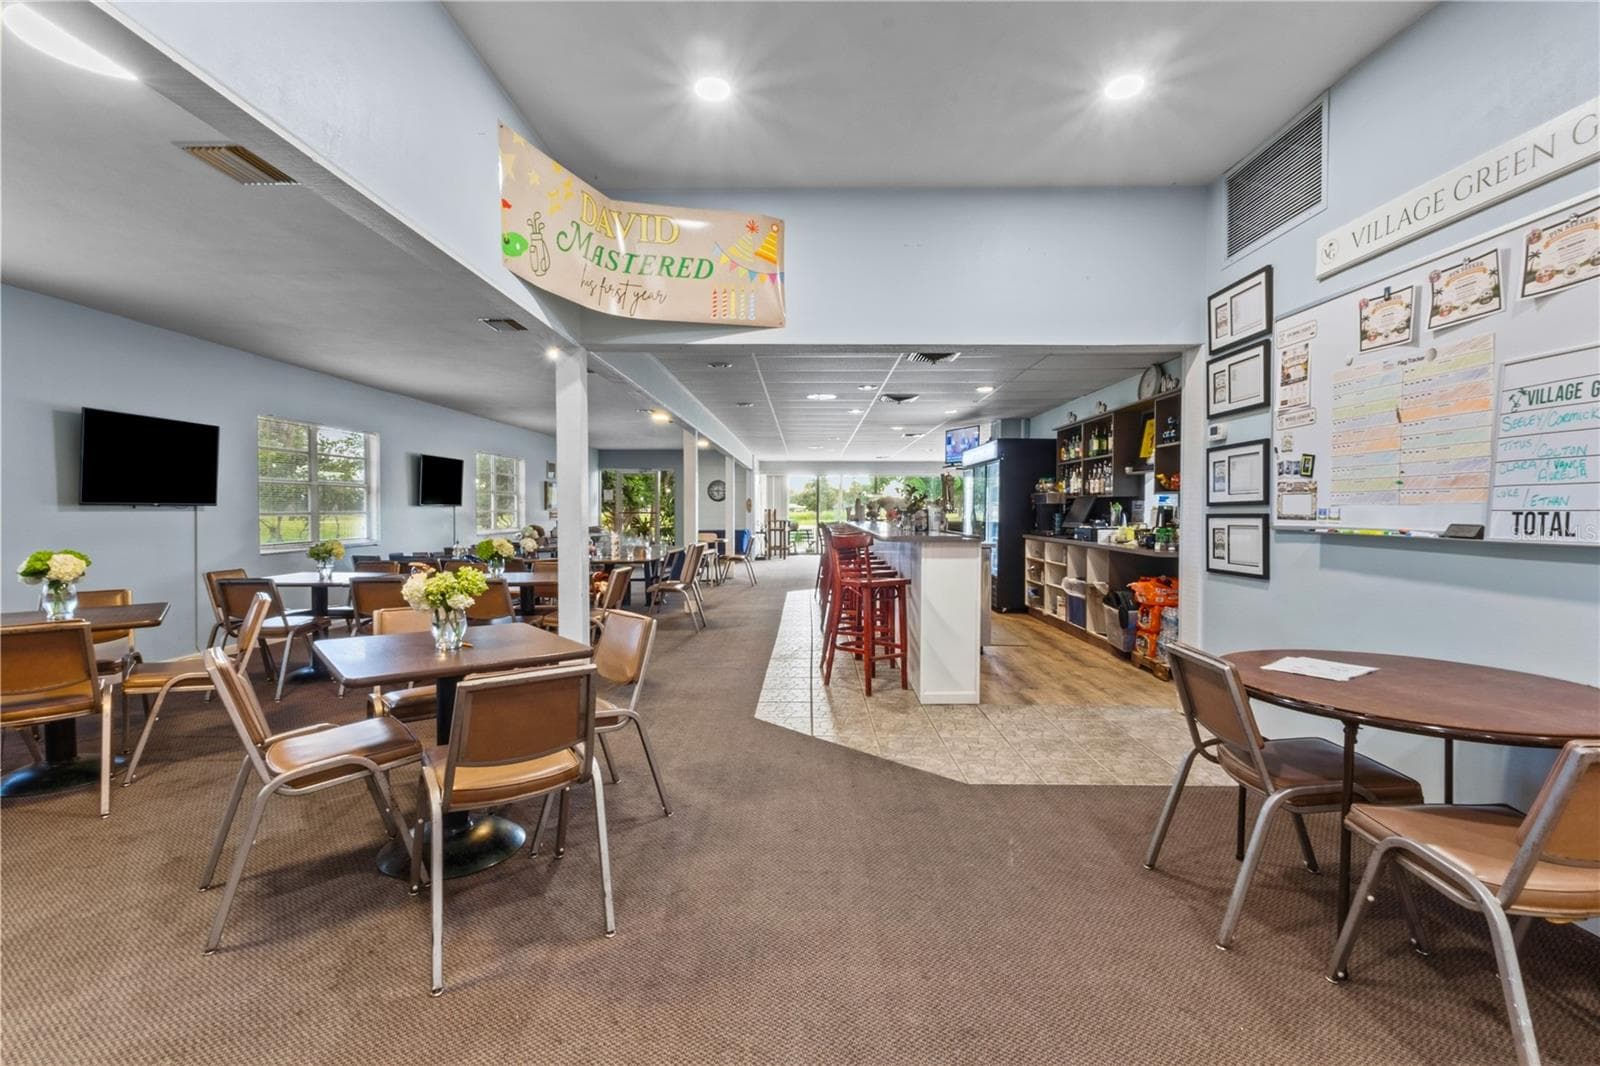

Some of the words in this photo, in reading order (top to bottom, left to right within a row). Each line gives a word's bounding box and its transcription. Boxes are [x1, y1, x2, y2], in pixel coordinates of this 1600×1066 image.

[580, 191, 680, 246] DAVID
[1351, 188, 1446, 249] VILLAGE
[1452, 133, 1558, 202] GREEN
[580, 262, 598, 296] his
[598, 277, 648, 311] first
[630, 288, 668, 317] year
[1527, 381, 1584, 407] VILLAGE
[1512, 511, 1576, 537] TOTAL
